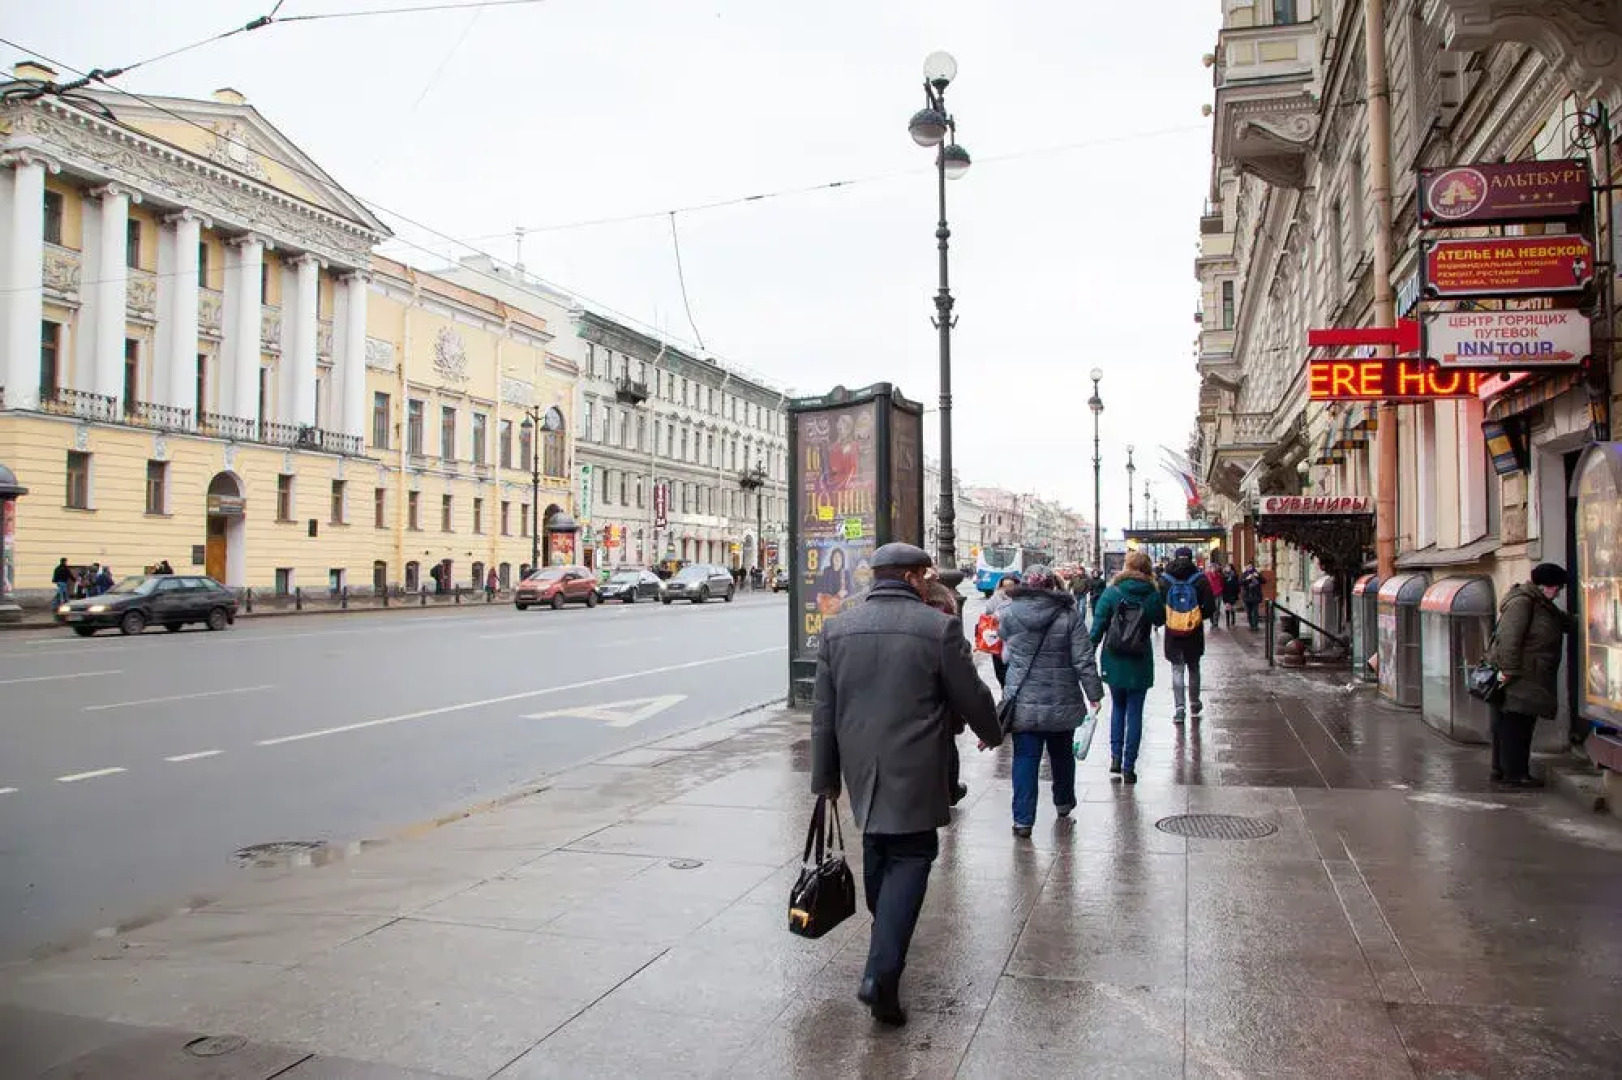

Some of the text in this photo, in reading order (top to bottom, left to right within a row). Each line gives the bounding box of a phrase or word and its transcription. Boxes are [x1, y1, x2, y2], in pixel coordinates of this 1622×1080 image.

[1490, 169, 1585, 188] АЛЬТБУРГ
[1437, 245, 1588, 261] АТЕЛЬЕ НА НЕВСКОМ
[1449, 313, 1568, 328] ЦЕНТР ГОРЯЩИХ
[1475, 327, 1539, 340] ПУТЕВОК
[1265, 496, 1369, 513] СУВЕНИРЫ
[807, 548, 819, 571] 8
